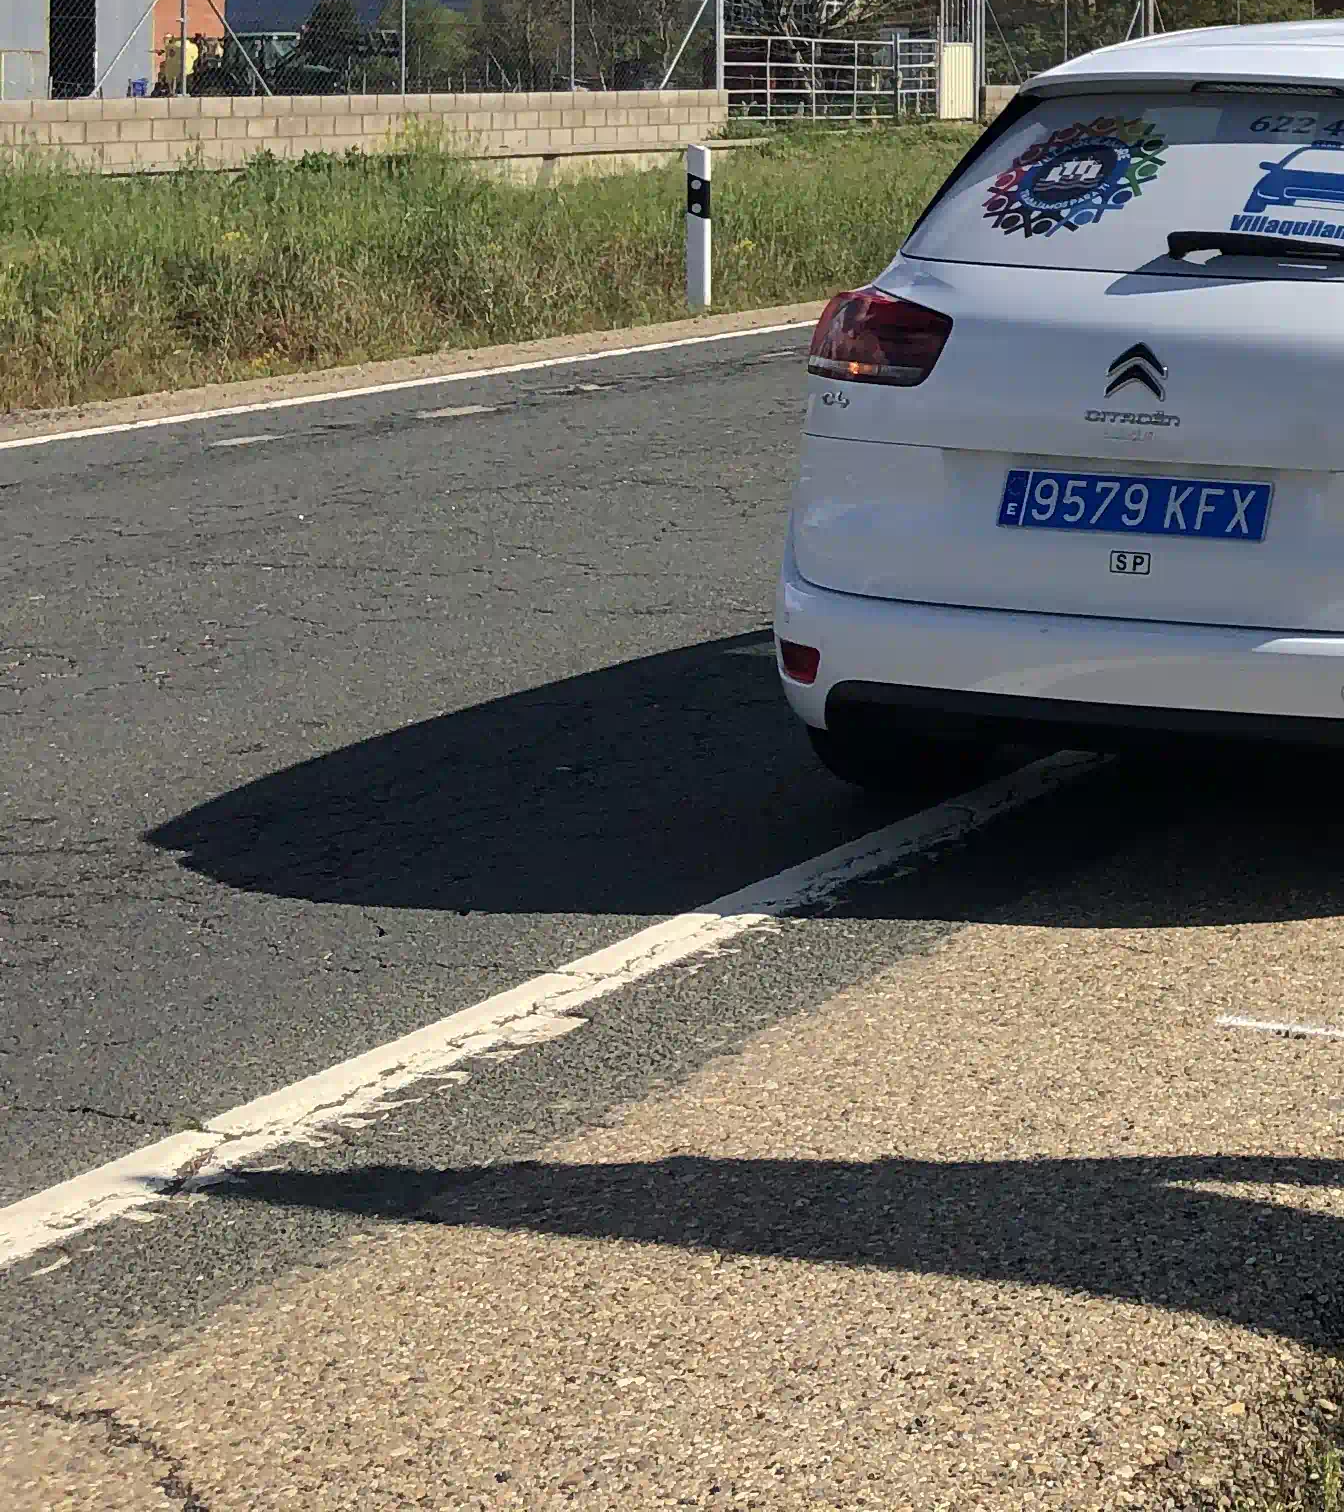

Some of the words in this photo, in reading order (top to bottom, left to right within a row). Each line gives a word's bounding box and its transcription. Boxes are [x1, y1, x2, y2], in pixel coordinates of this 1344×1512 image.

[1250, 115, 1316, 134] 622
[1085, 410, 1181, 427] CITROËN
[1006, 503, 1018, 516] E
[1031, 478, 1149, 527] 9579
[1163, 485, 1256, 534] KFX
